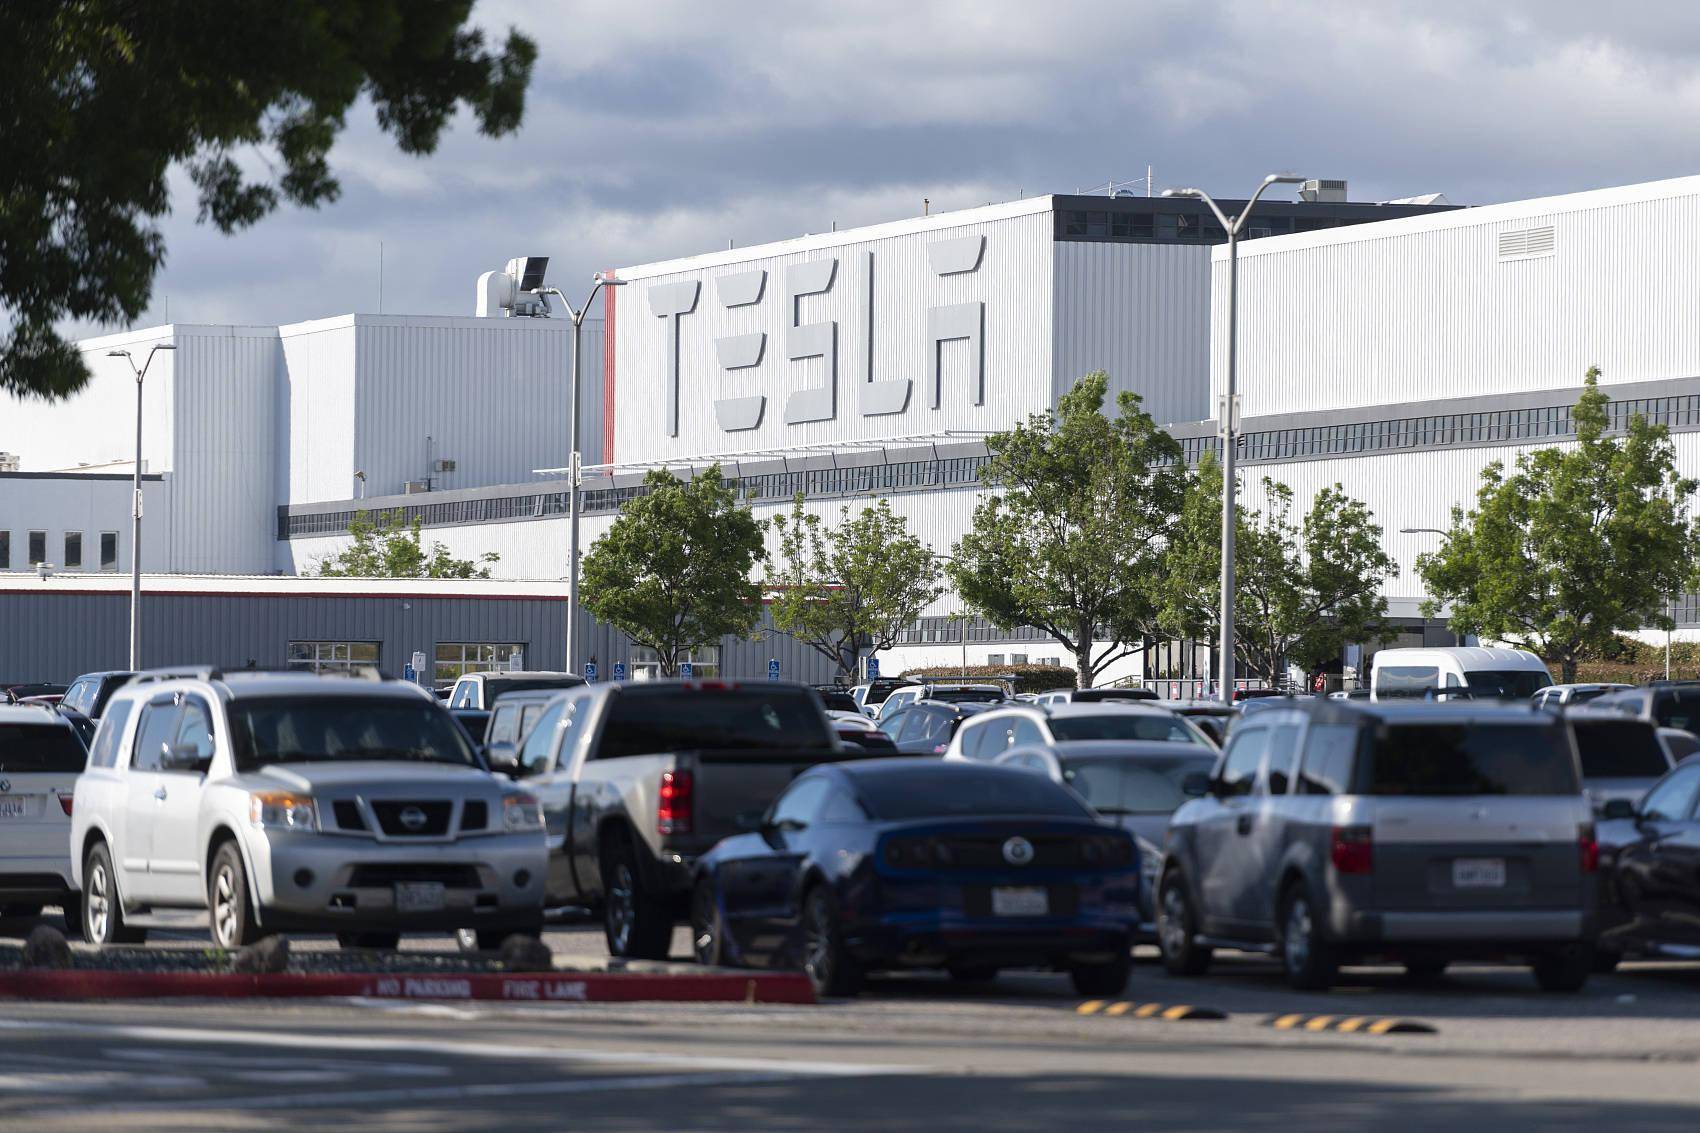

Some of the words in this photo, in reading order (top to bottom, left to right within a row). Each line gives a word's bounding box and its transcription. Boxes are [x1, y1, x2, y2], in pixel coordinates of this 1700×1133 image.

[648, 234, 986, 437] TESLA
[377, 978, 398, 996] NO
[404, 978, 472, 997] PARKING
[503, 980, 541, 998] FIRE
[544, 980, 587, 999] LANE
